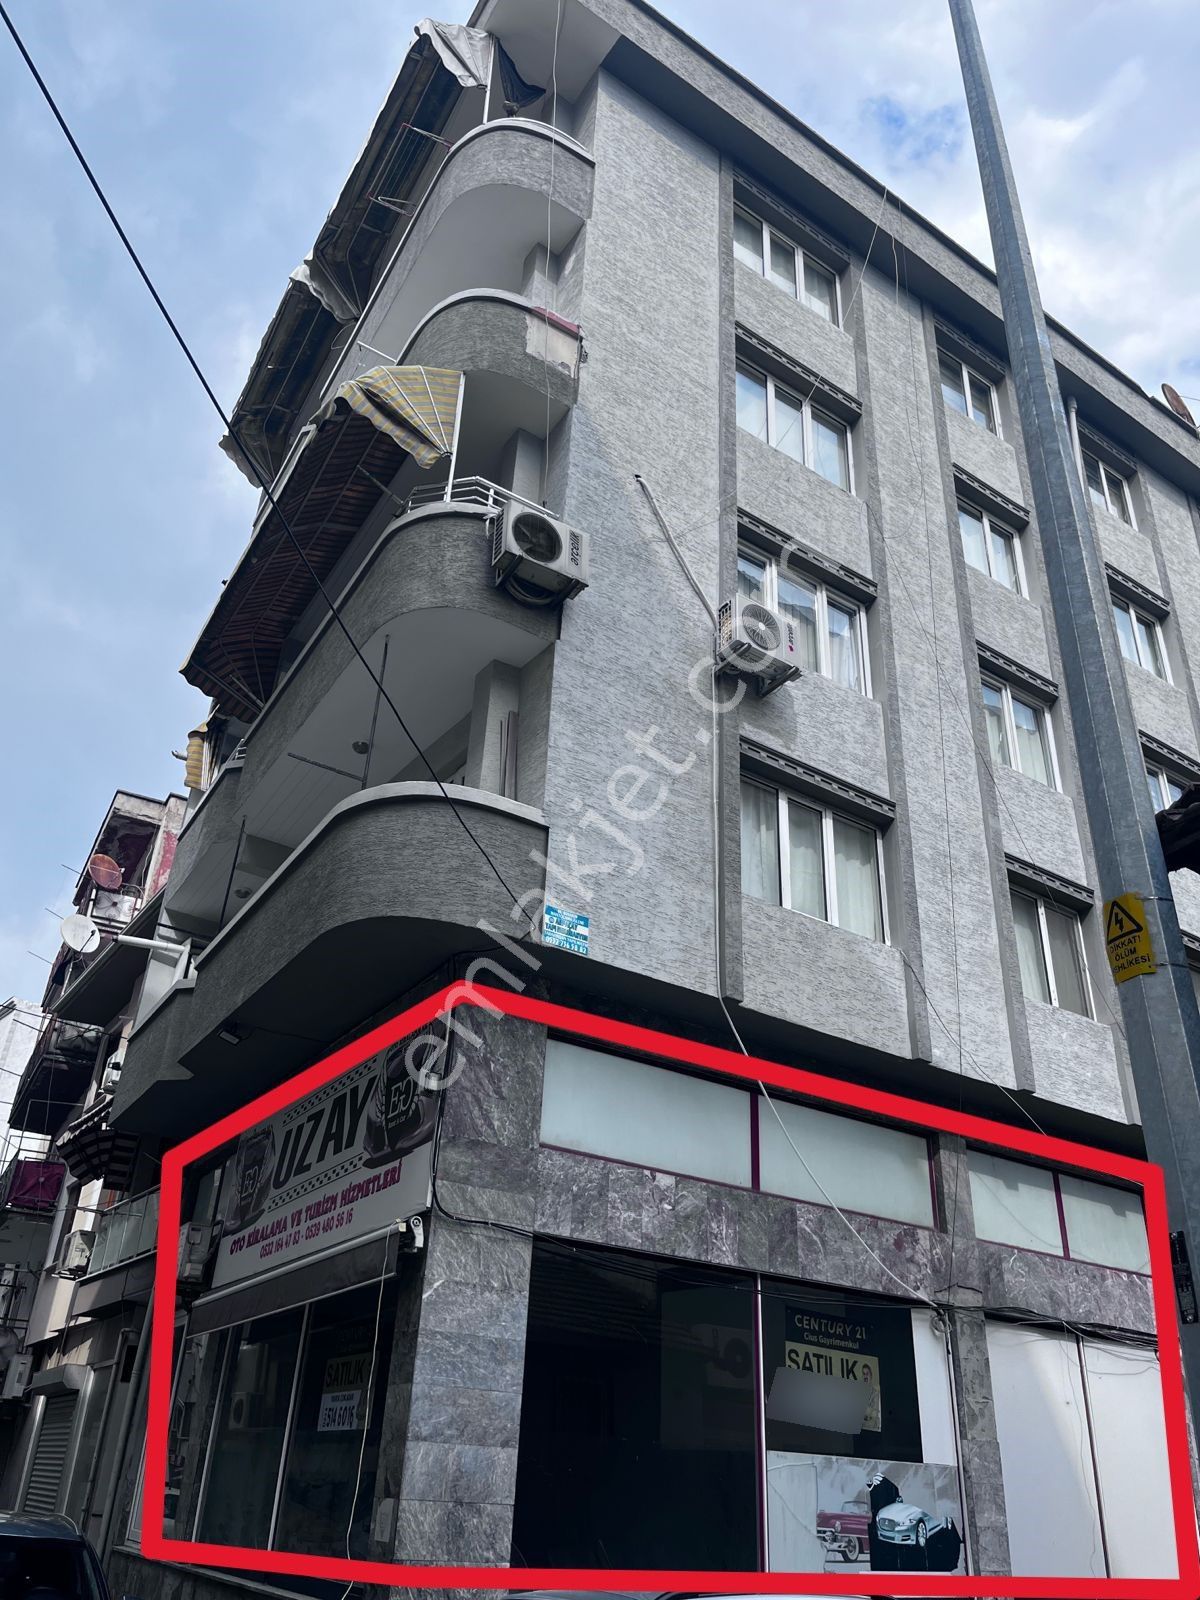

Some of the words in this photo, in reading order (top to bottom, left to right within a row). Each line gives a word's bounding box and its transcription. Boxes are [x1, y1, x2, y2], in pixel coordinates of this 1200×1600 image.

[273, 1075, 377, 1190] UZAY
[229, 1234, 246, 1256] OTO
[291, 1208, 303, 1229] VE
[305, 1192, 339, 1223] TURİZM
[339, 1157, 403, 1208] HİZMETLERİ
[794, 1314, 852, 1337] CENTURY
[855, 1327, 867, 1340] 21
[818, 1335, 859, 1350] Gayrimenkul
[326, 1359, 366, 1388] SATILIK
